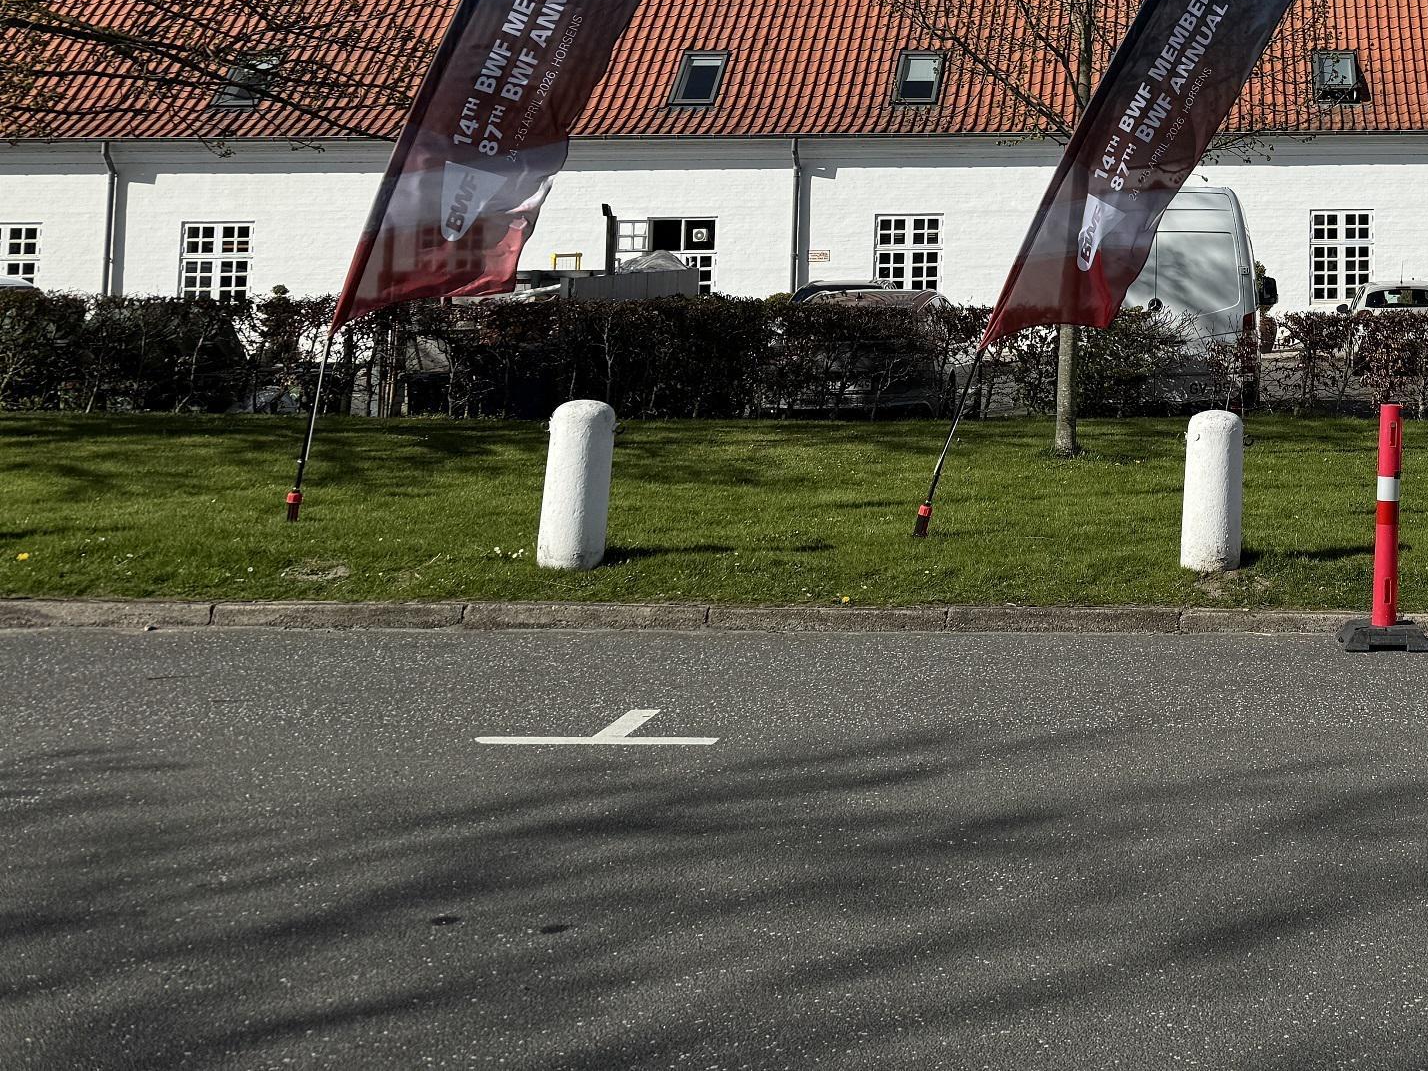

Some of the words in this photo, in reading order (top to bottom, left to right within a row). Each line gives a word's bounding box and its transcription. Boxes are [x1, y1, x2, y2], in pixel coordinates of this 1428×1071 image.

[453, 97, 481, 145] 14TH
[474, 39, 512, 94] BWF
[479, 104, 506, 156] 87TH
[500, 48, 539, 102] BWF
[521, 98, 543, 128] APRIL
[551, 14, 583, 68] HORSENS
[1110, 143, 1137, 191] 87TH
[1135, 92, 1172, 144] BWF
[1170, 3, 1229, 95] ANNUAL
[1148, 143, 1170, 170] APRIL
[1184, 67, 1212, 114] HORSENS
[1094, 135, 1121, 179] 14TH
[1118, 82, 1152, 133] BWF
[446, 172, 478, 233] BWF
